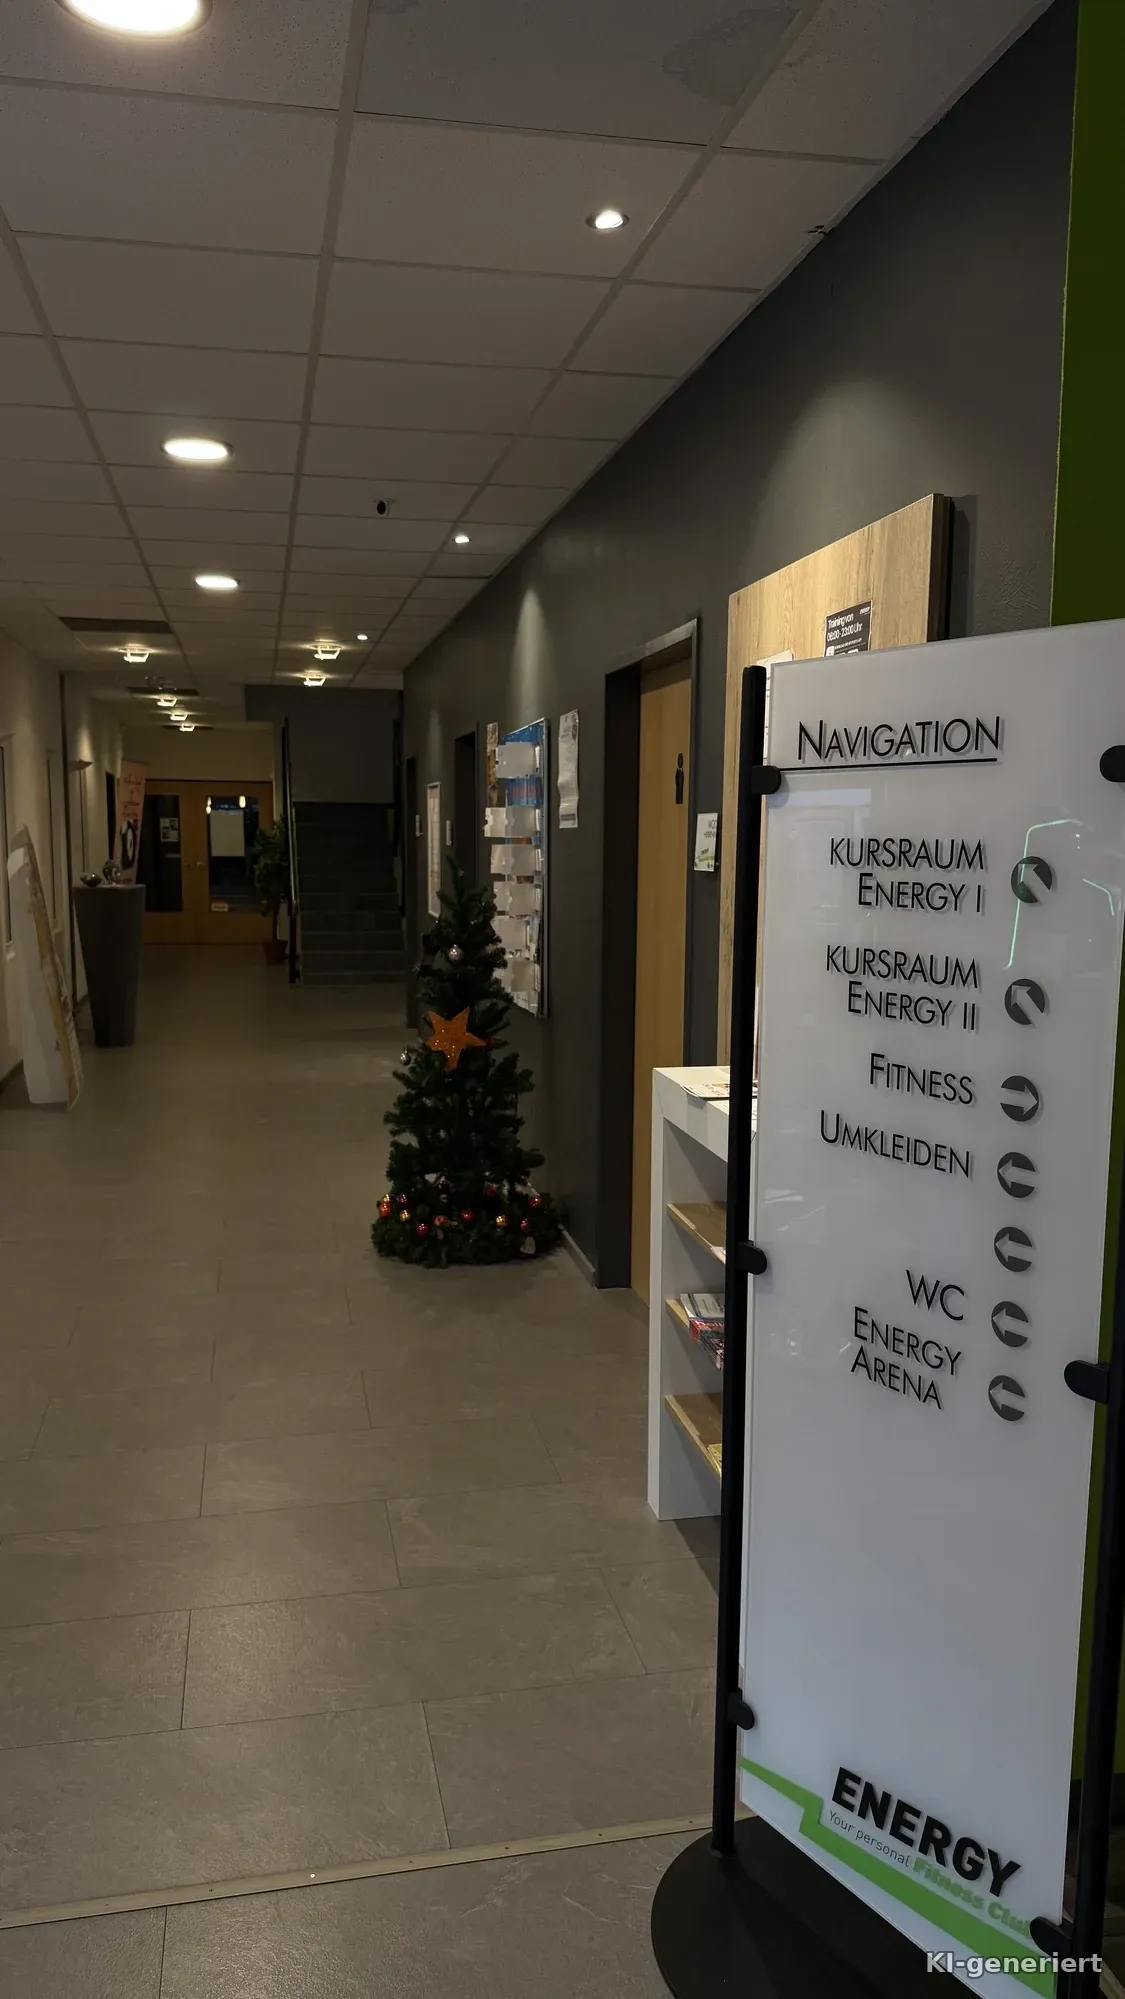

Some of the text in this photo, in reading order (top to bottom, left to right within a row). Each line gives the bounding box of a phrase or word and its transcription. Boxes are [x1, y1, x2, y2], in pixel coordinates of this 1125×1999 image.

[798, 716, 1000, 760] NAVIGATION
[830, 838, 984, 870] KURSRAUM
[858, 873, 982, 912] ENERGY I
[826, 945, 978, 989] KURSRAUM
[847, 981, 976, 1031] ENERGY II
[869, 1053, 973, 1105] FITNESS
[820, 1110, 970, 1178] UMKLEIDEN
[906, 1270, 965, 1320] WC
[854, 1306, 961, 1375] ENERGY
[851, 1345, 942, 1409] ARENA
[832, 1767, 1021, 1897] ENERGY
[829, 1810, 855, 1833] Your
[856, 1827, 910, 1868] personal
[912, 1857, 985, 1910] Fitness
